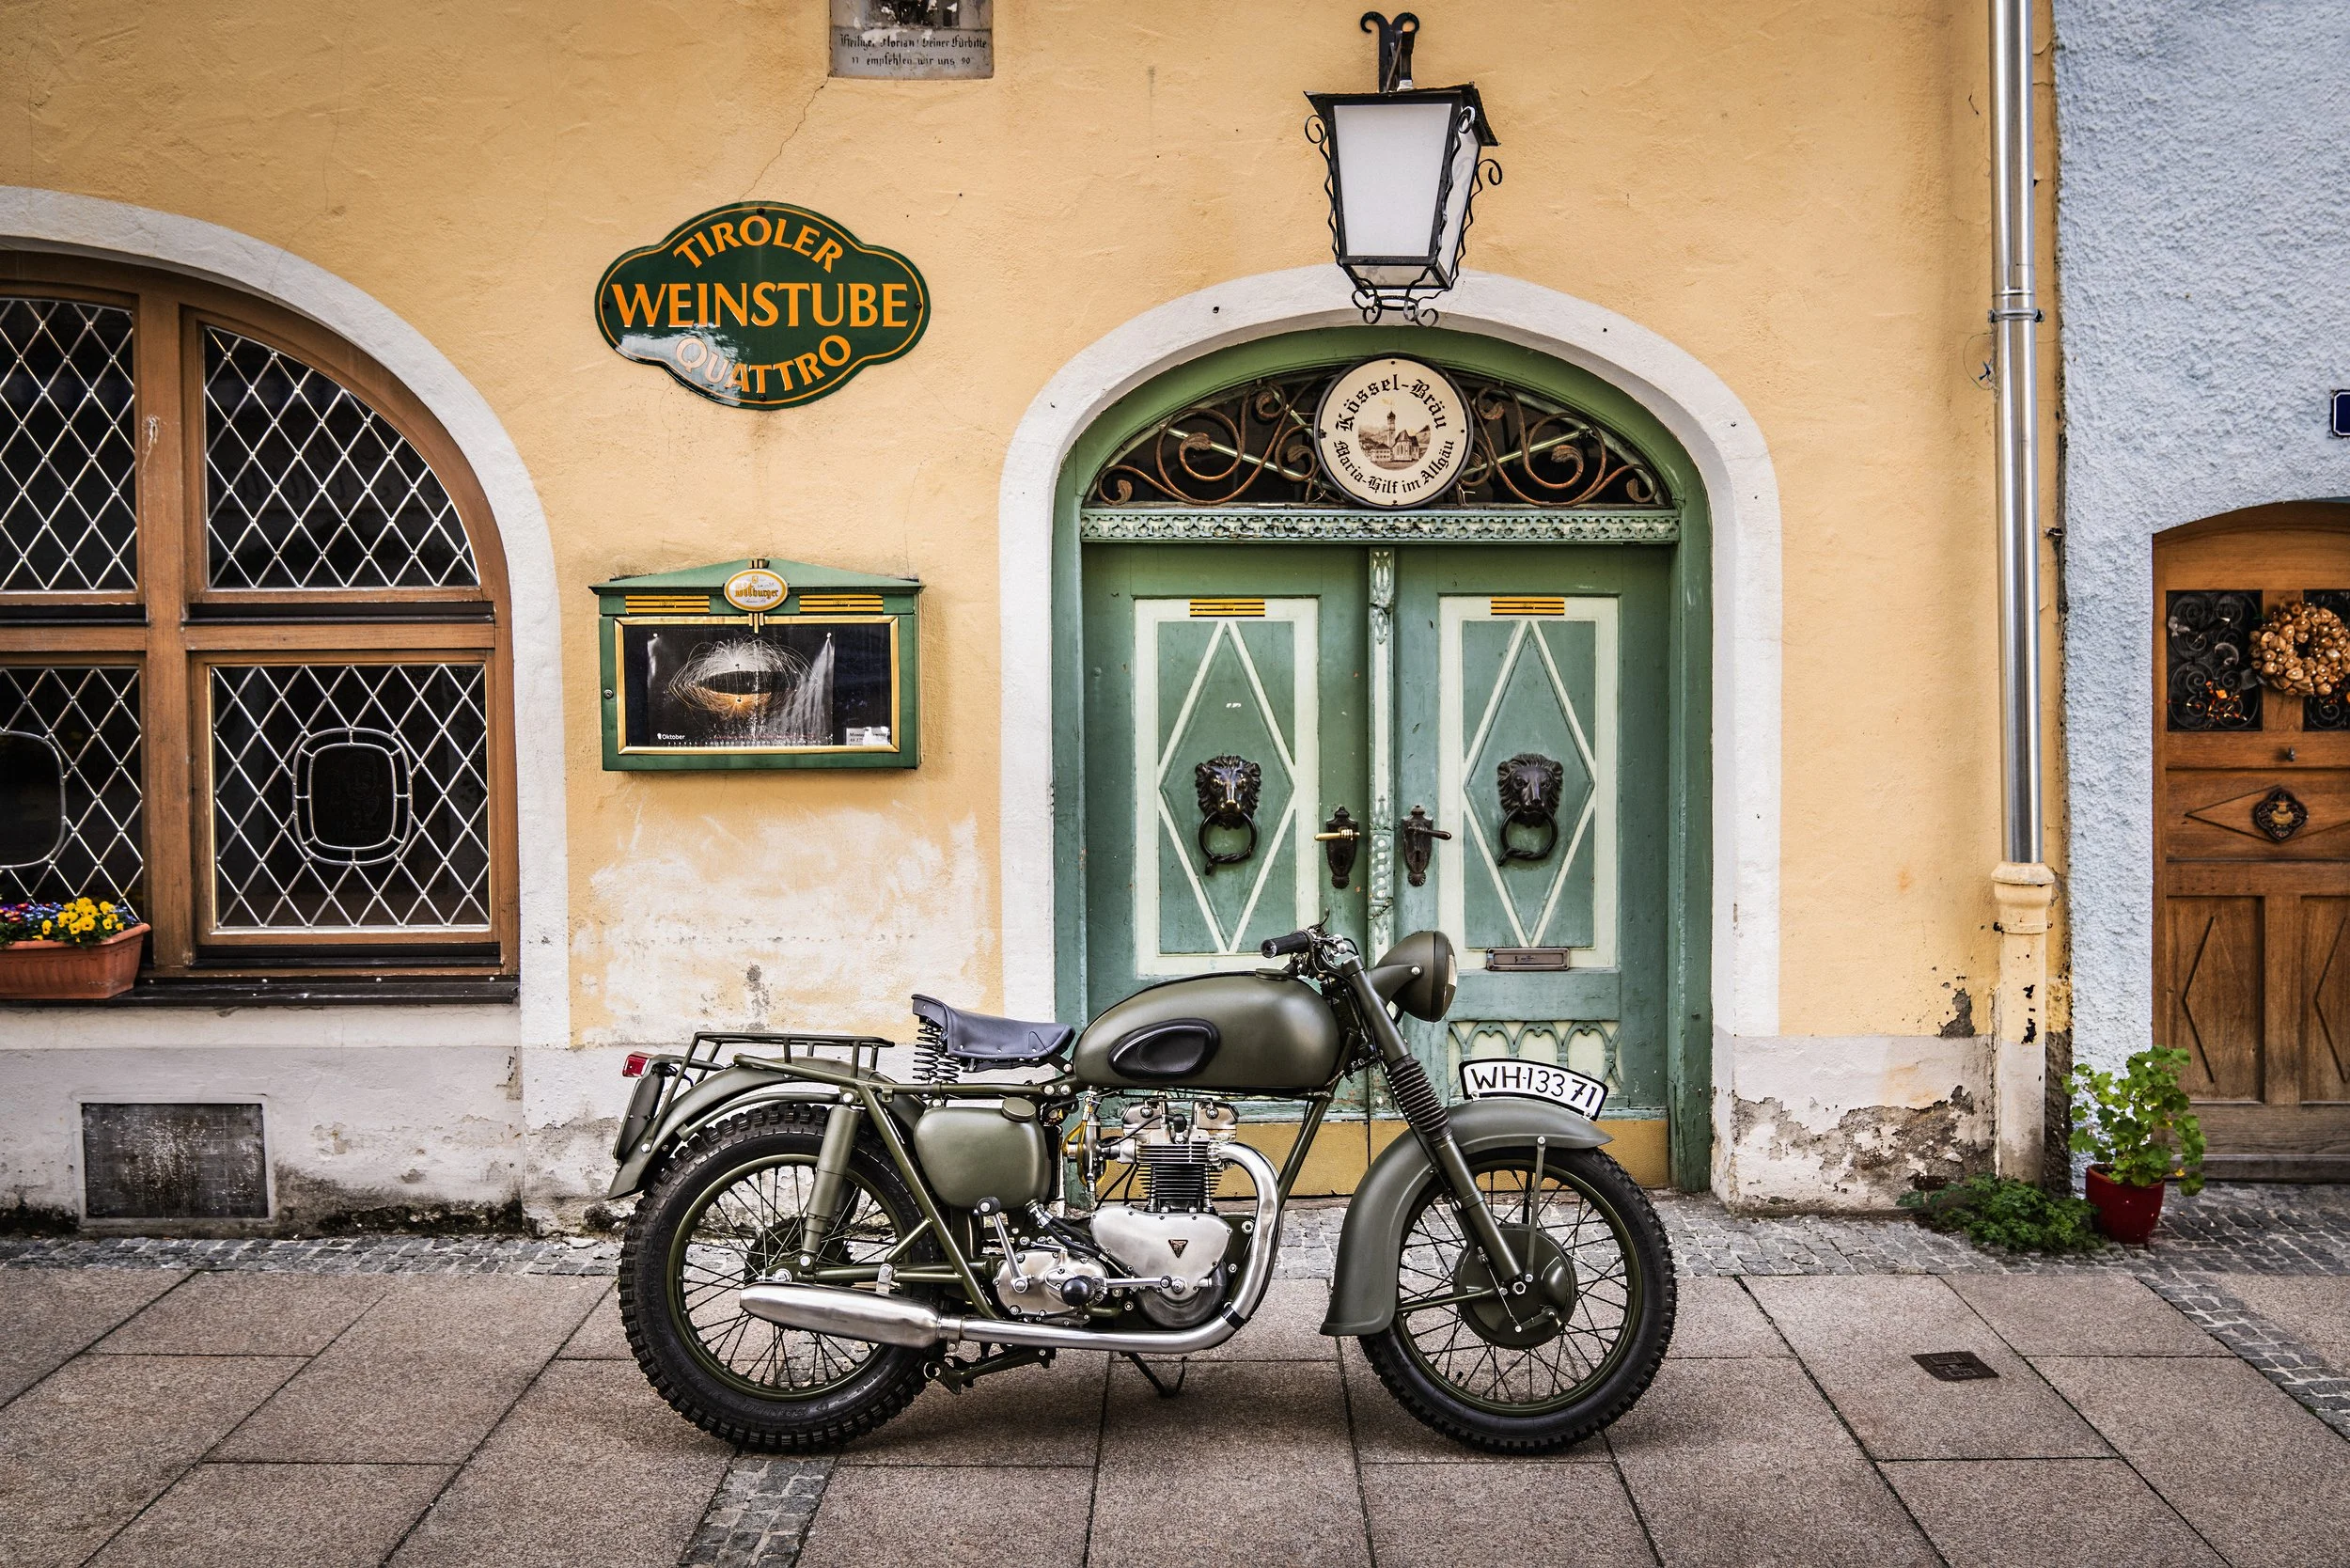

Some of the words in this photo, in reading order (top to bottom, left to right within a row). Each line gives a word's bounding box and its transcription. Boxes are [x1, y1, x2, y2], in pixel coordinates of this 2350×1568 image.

[917, 57, 934, 66] wir
[673, 215, 843, 274] TIROLER
[611, 282, 910, 328] WEINSTUBE
[675, 335, 852, 394] QUATTRO
[1333, 440, 1399, 494] Maria-Hilf
[1402, 478, 1421, 494] im
[1421, 440, 1455, 485] Allgäu
